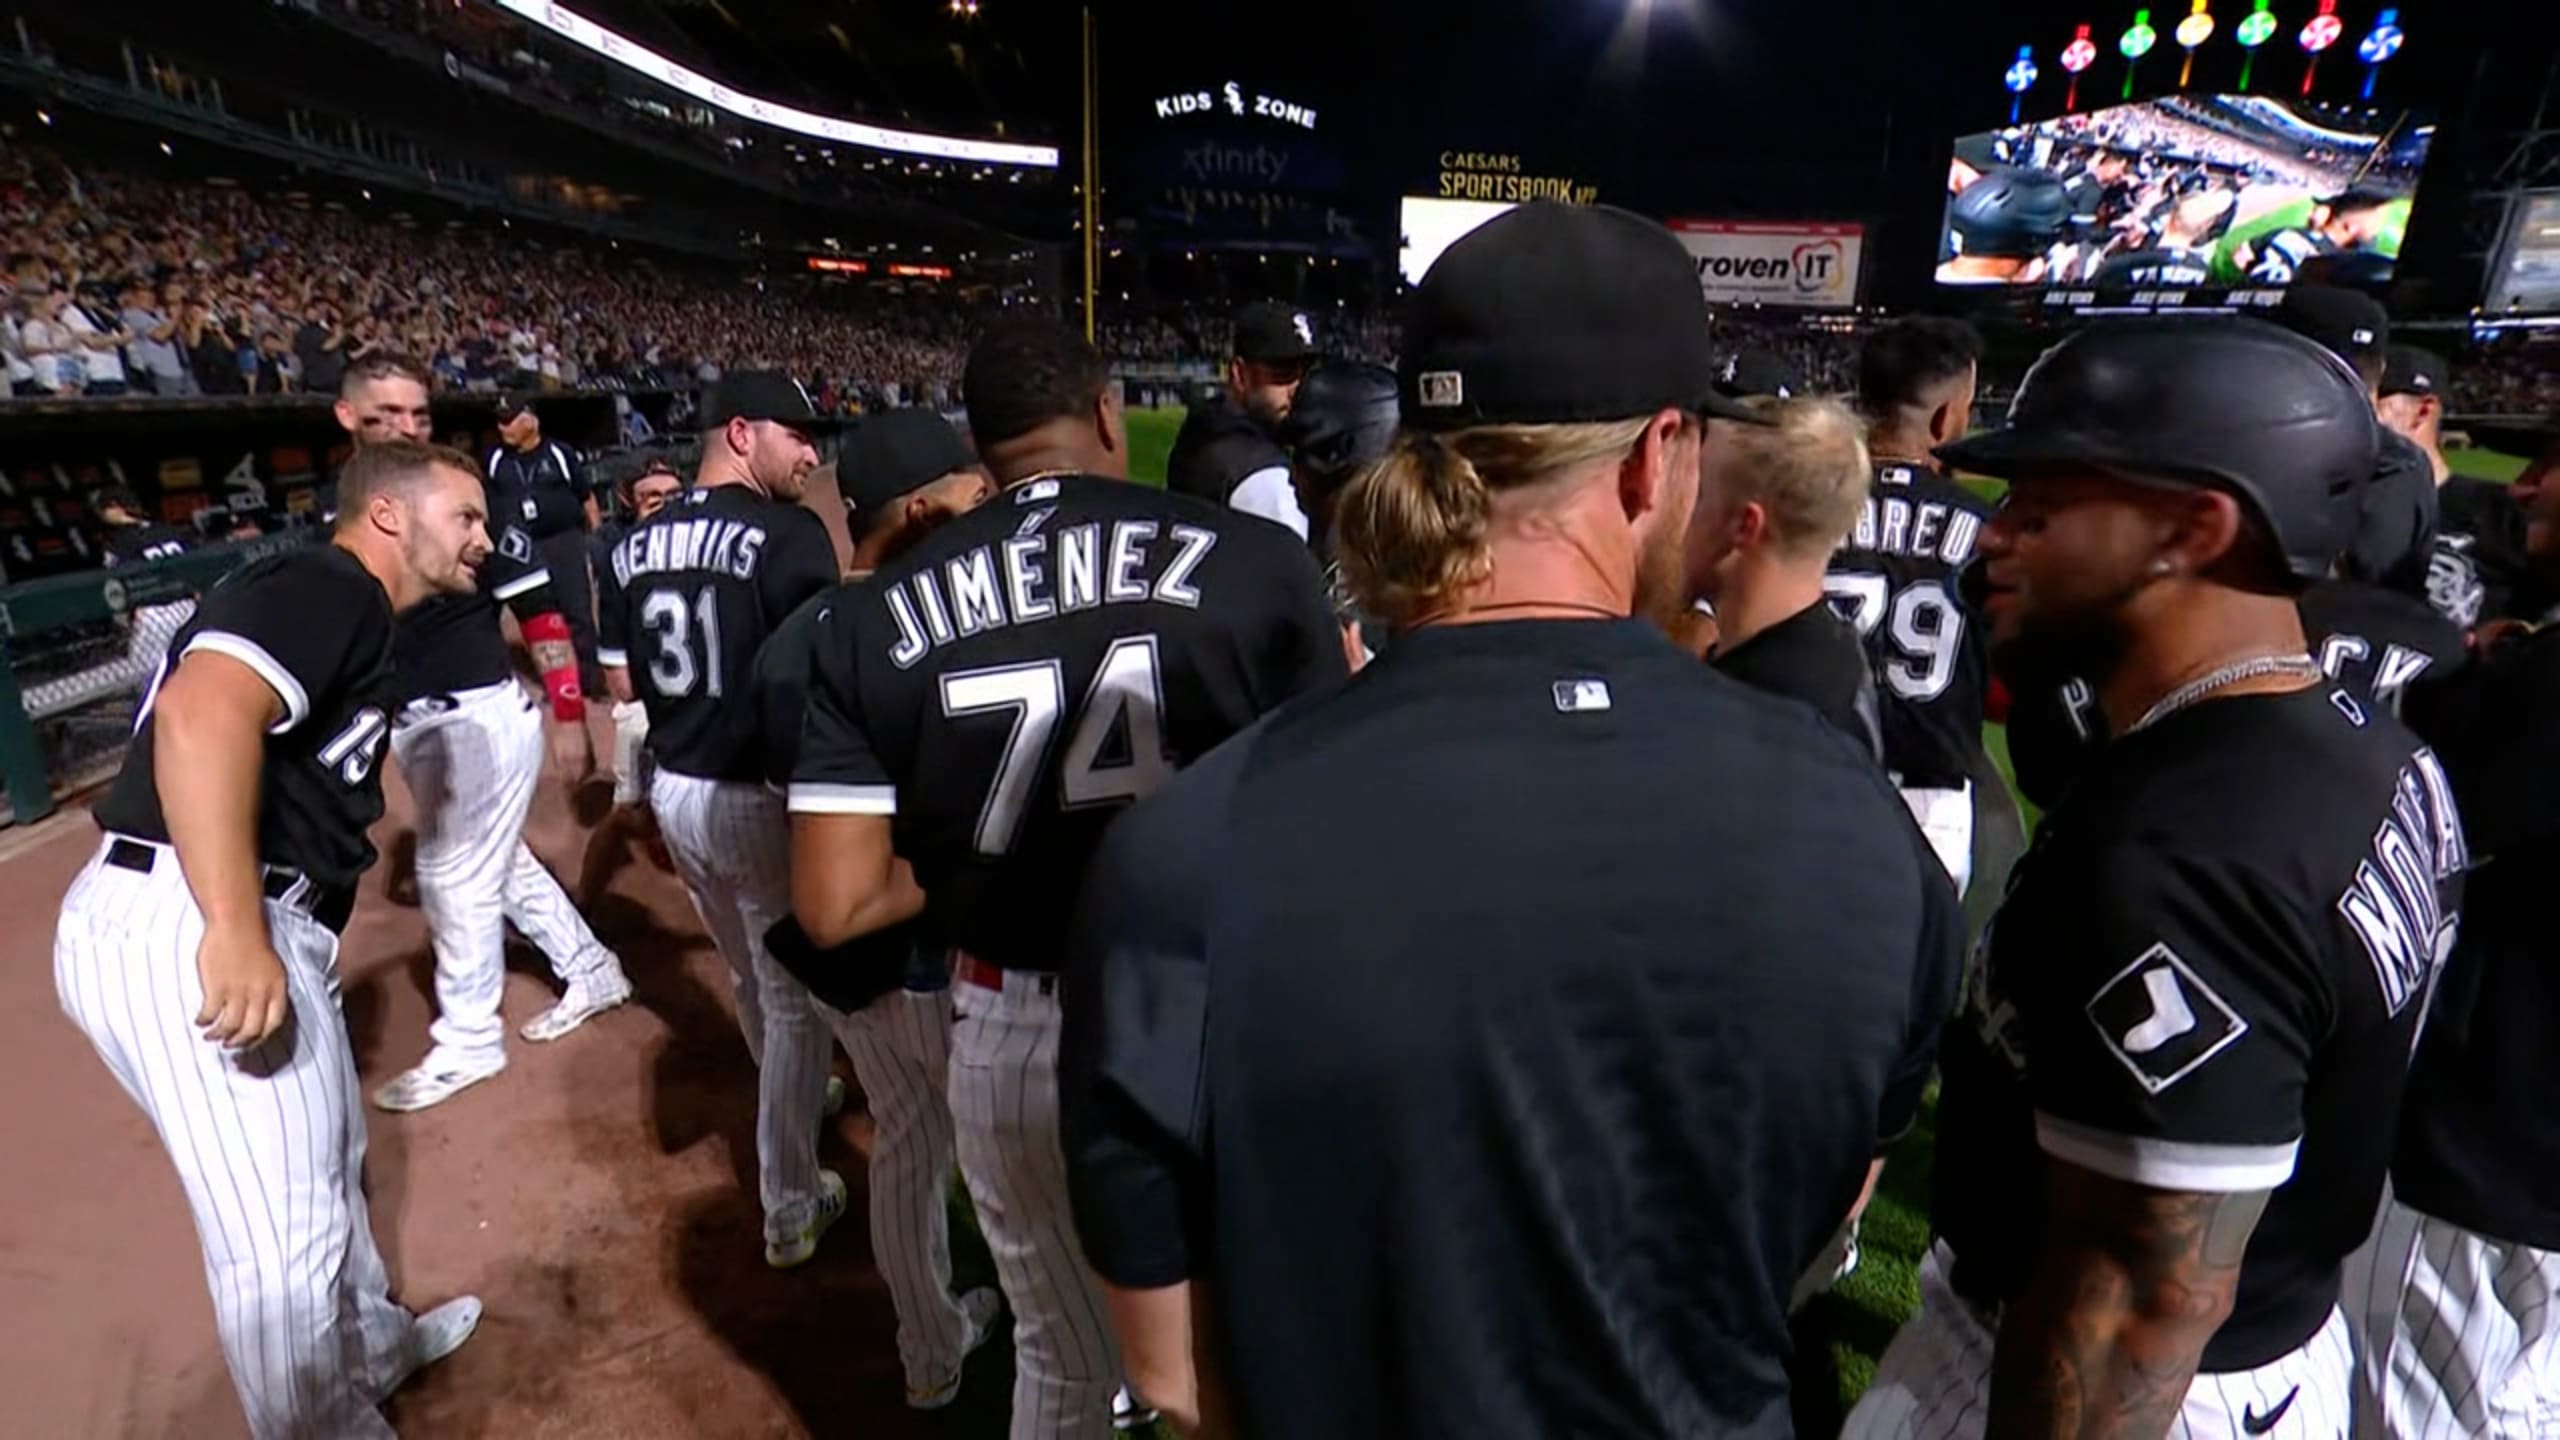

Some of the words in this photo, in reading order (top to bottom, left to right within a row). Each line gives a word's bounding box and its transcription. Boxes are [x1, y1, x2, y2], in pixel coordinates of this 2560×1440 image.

[1155, 91, 1213, 118] KIDS
[1254, 95, 1317, 129] ZONE
[1183, 139, 1289, 185] xfinity
[1439, 171, 1573, 205] SPORTSBOOK
[1440, 150, 1521, 173] CAESARS
[1693, 253, 1790, 280] roven
[1804, 252, 1832, 279] IT
[610, 518, 767, 591] HENDRIKS
[1838, 496, 1983, 567] BREU
[884, 504, 1218, 671] JIMÉNEZ
[641, 584, 724, 699] 31
[1820, 570, 1968, 703] 79
[938, 632, 1178, 858] 74
